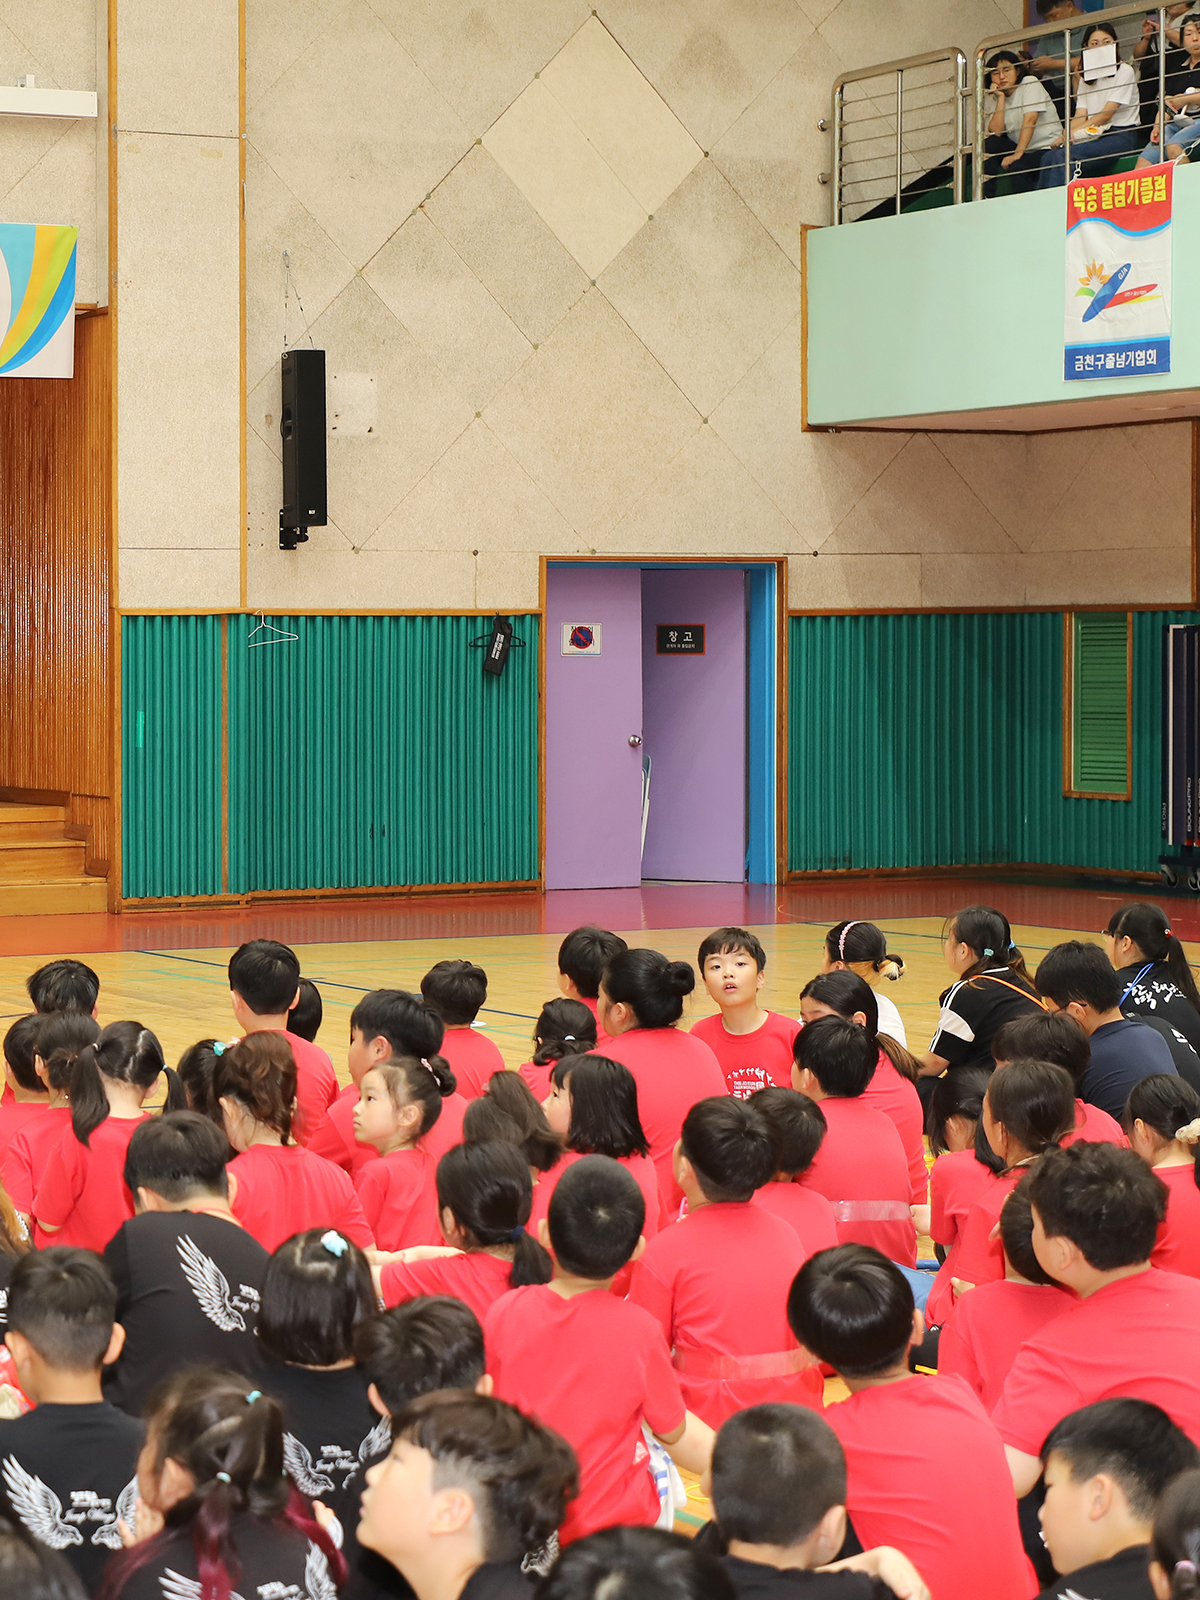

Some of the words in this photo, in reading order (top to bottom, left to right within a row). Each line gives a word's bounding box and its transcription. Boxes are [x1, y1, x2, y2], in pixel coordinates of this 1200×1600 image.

[1073, 185, 1097, 212] 덕승
[1101, 174, 1167, 209] 줄넘기클럽
[1074, 349, 1157, 372] 금천구줄넘기협회
